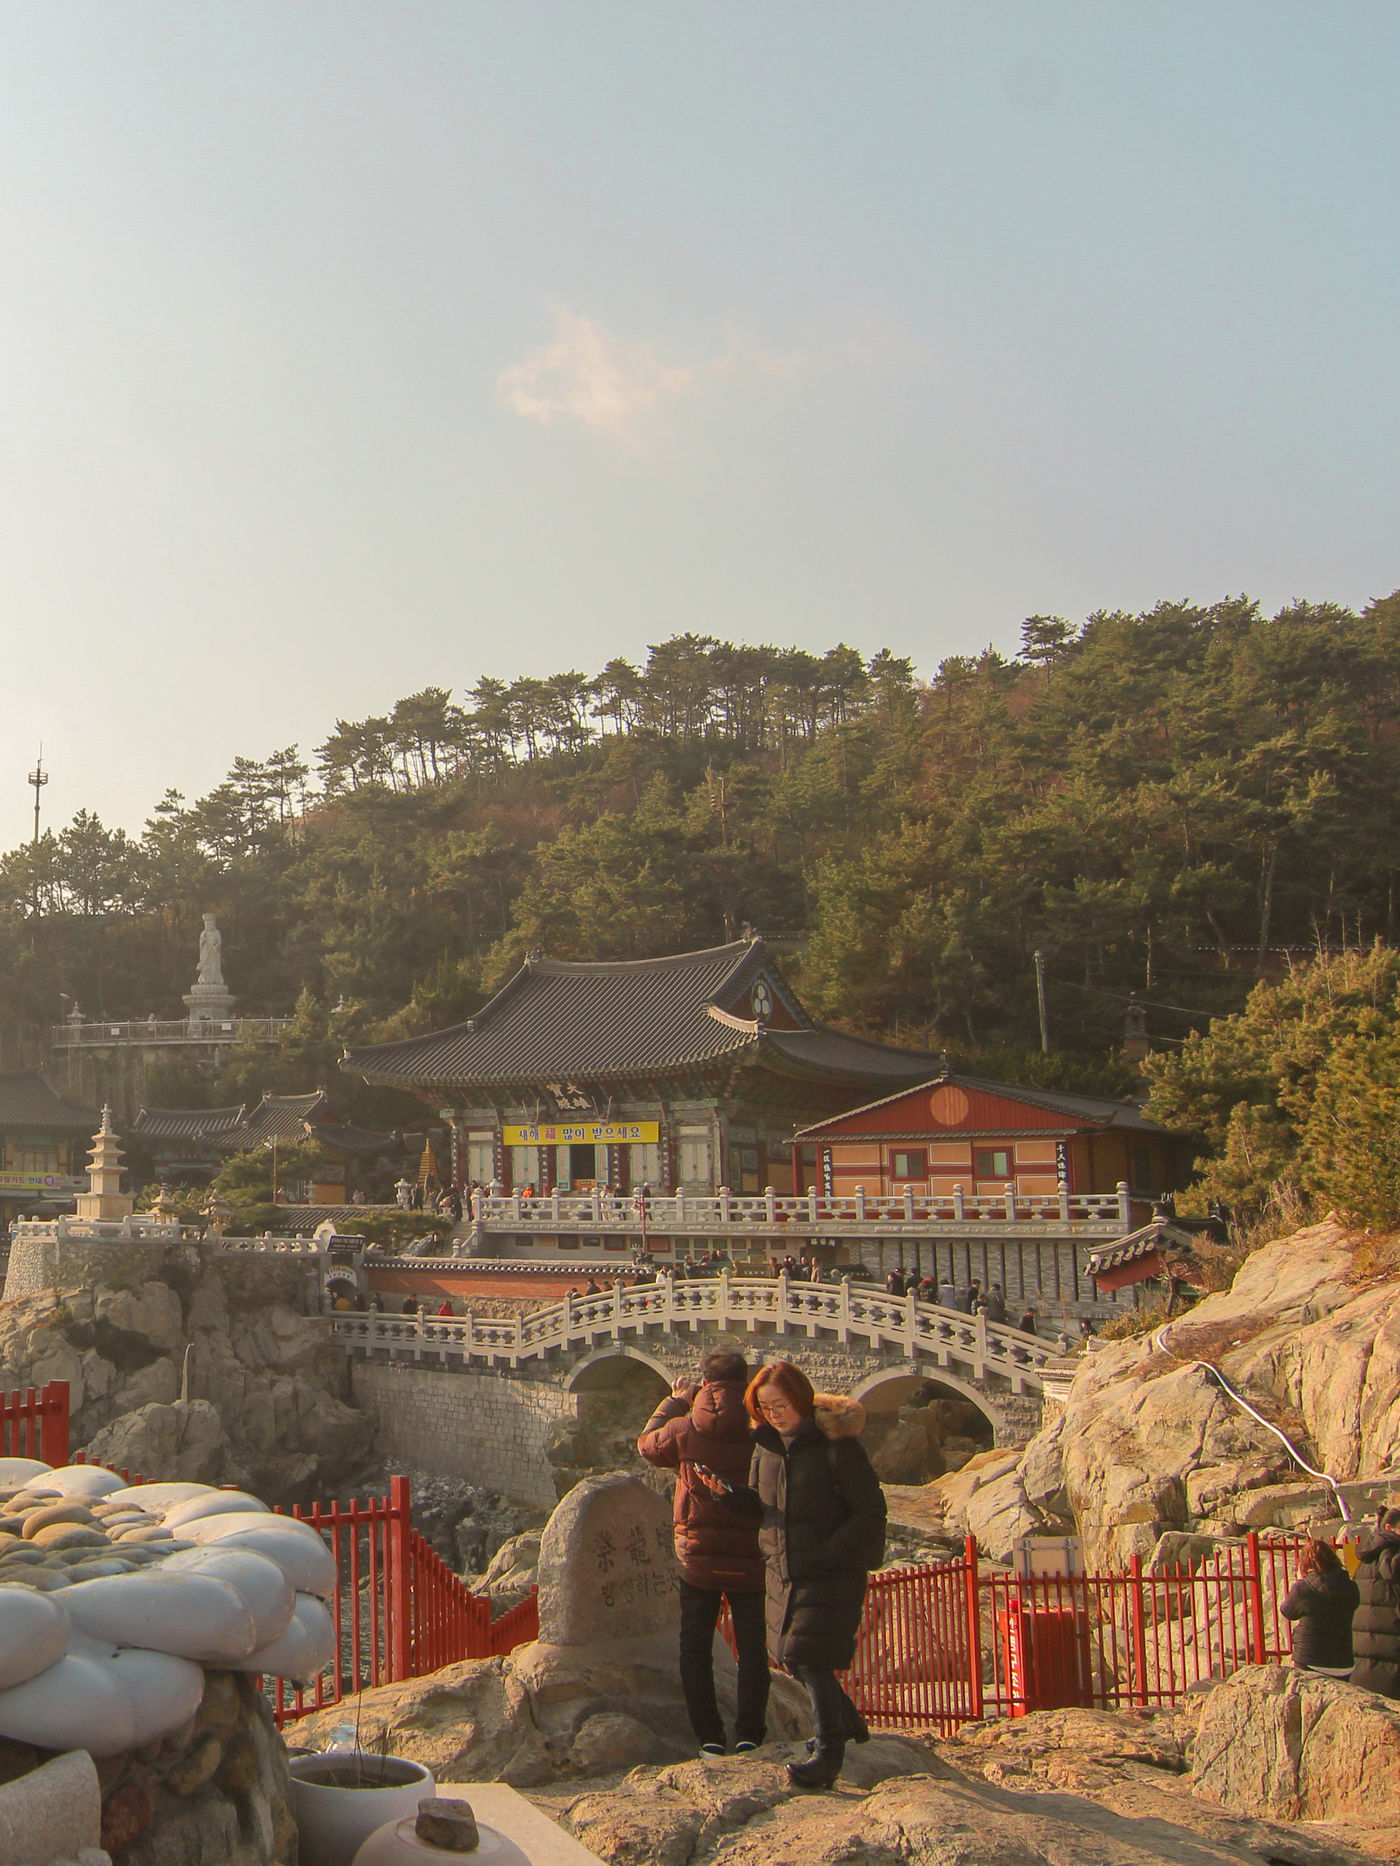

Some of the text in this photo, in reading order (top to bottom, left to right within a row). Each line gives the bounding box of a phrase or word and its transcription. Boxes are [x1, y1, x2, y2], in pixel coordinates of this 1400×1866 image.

[518, 1126, 641, 1141] 새해 福 많이 받으세요
